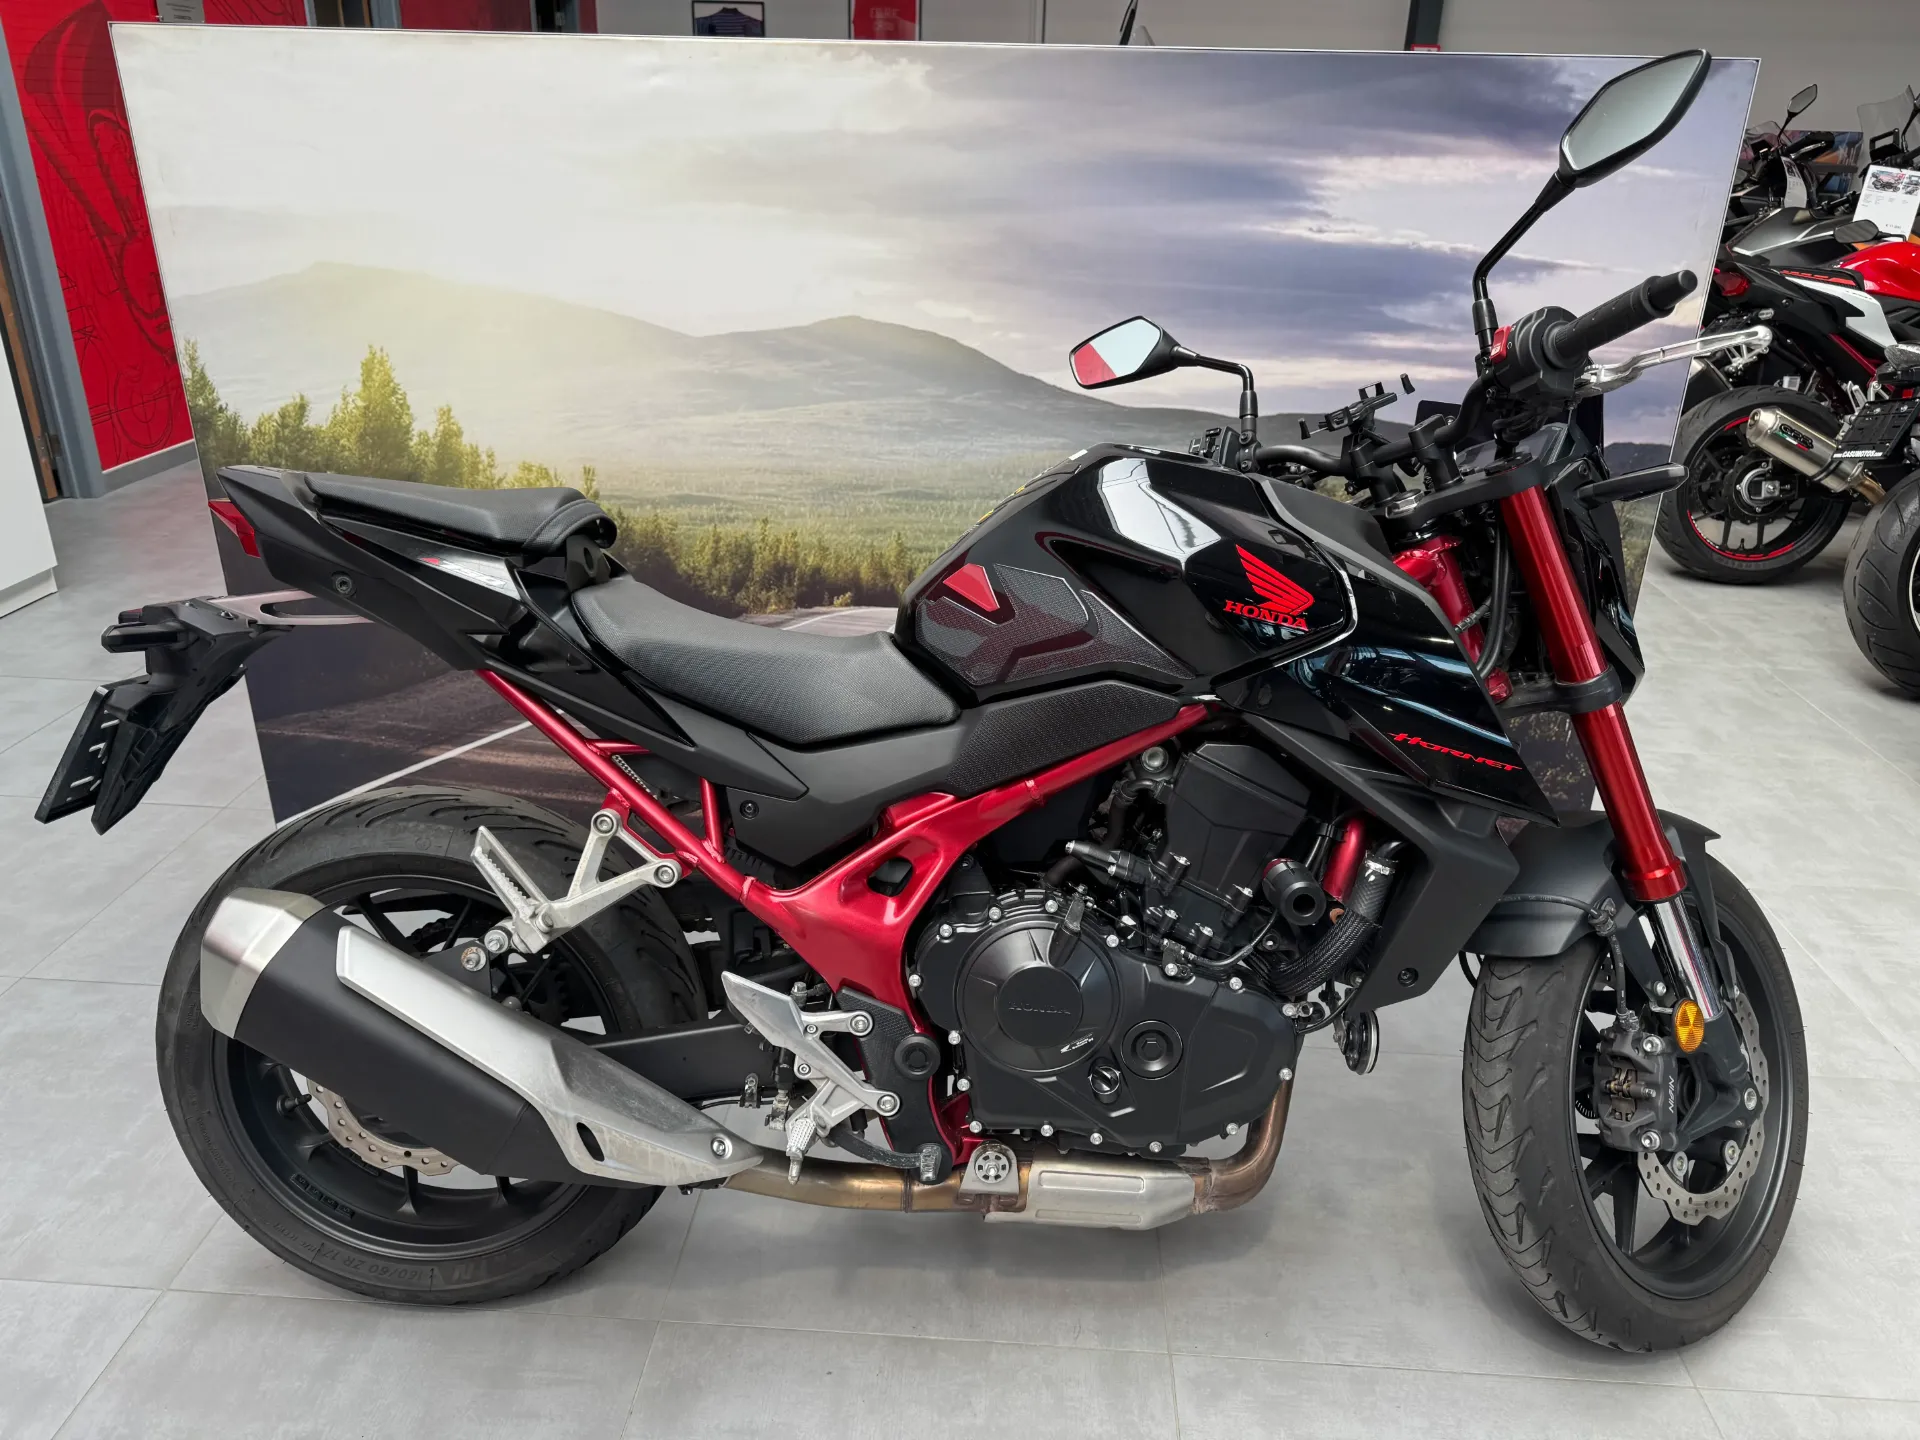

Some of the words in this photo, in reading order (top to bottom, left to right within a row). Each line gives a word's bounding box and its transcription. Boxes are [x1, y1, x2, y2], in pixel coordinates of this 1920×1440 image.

[1779, 423, 1814, 449] GPR
[1223, 599, 1309, 631] HONDA
[1008, 1001, 1071, 1014] HONDA
[343, 1256, 366, 1271] ZR
[368, 1264, 423, 1281] 160/60
